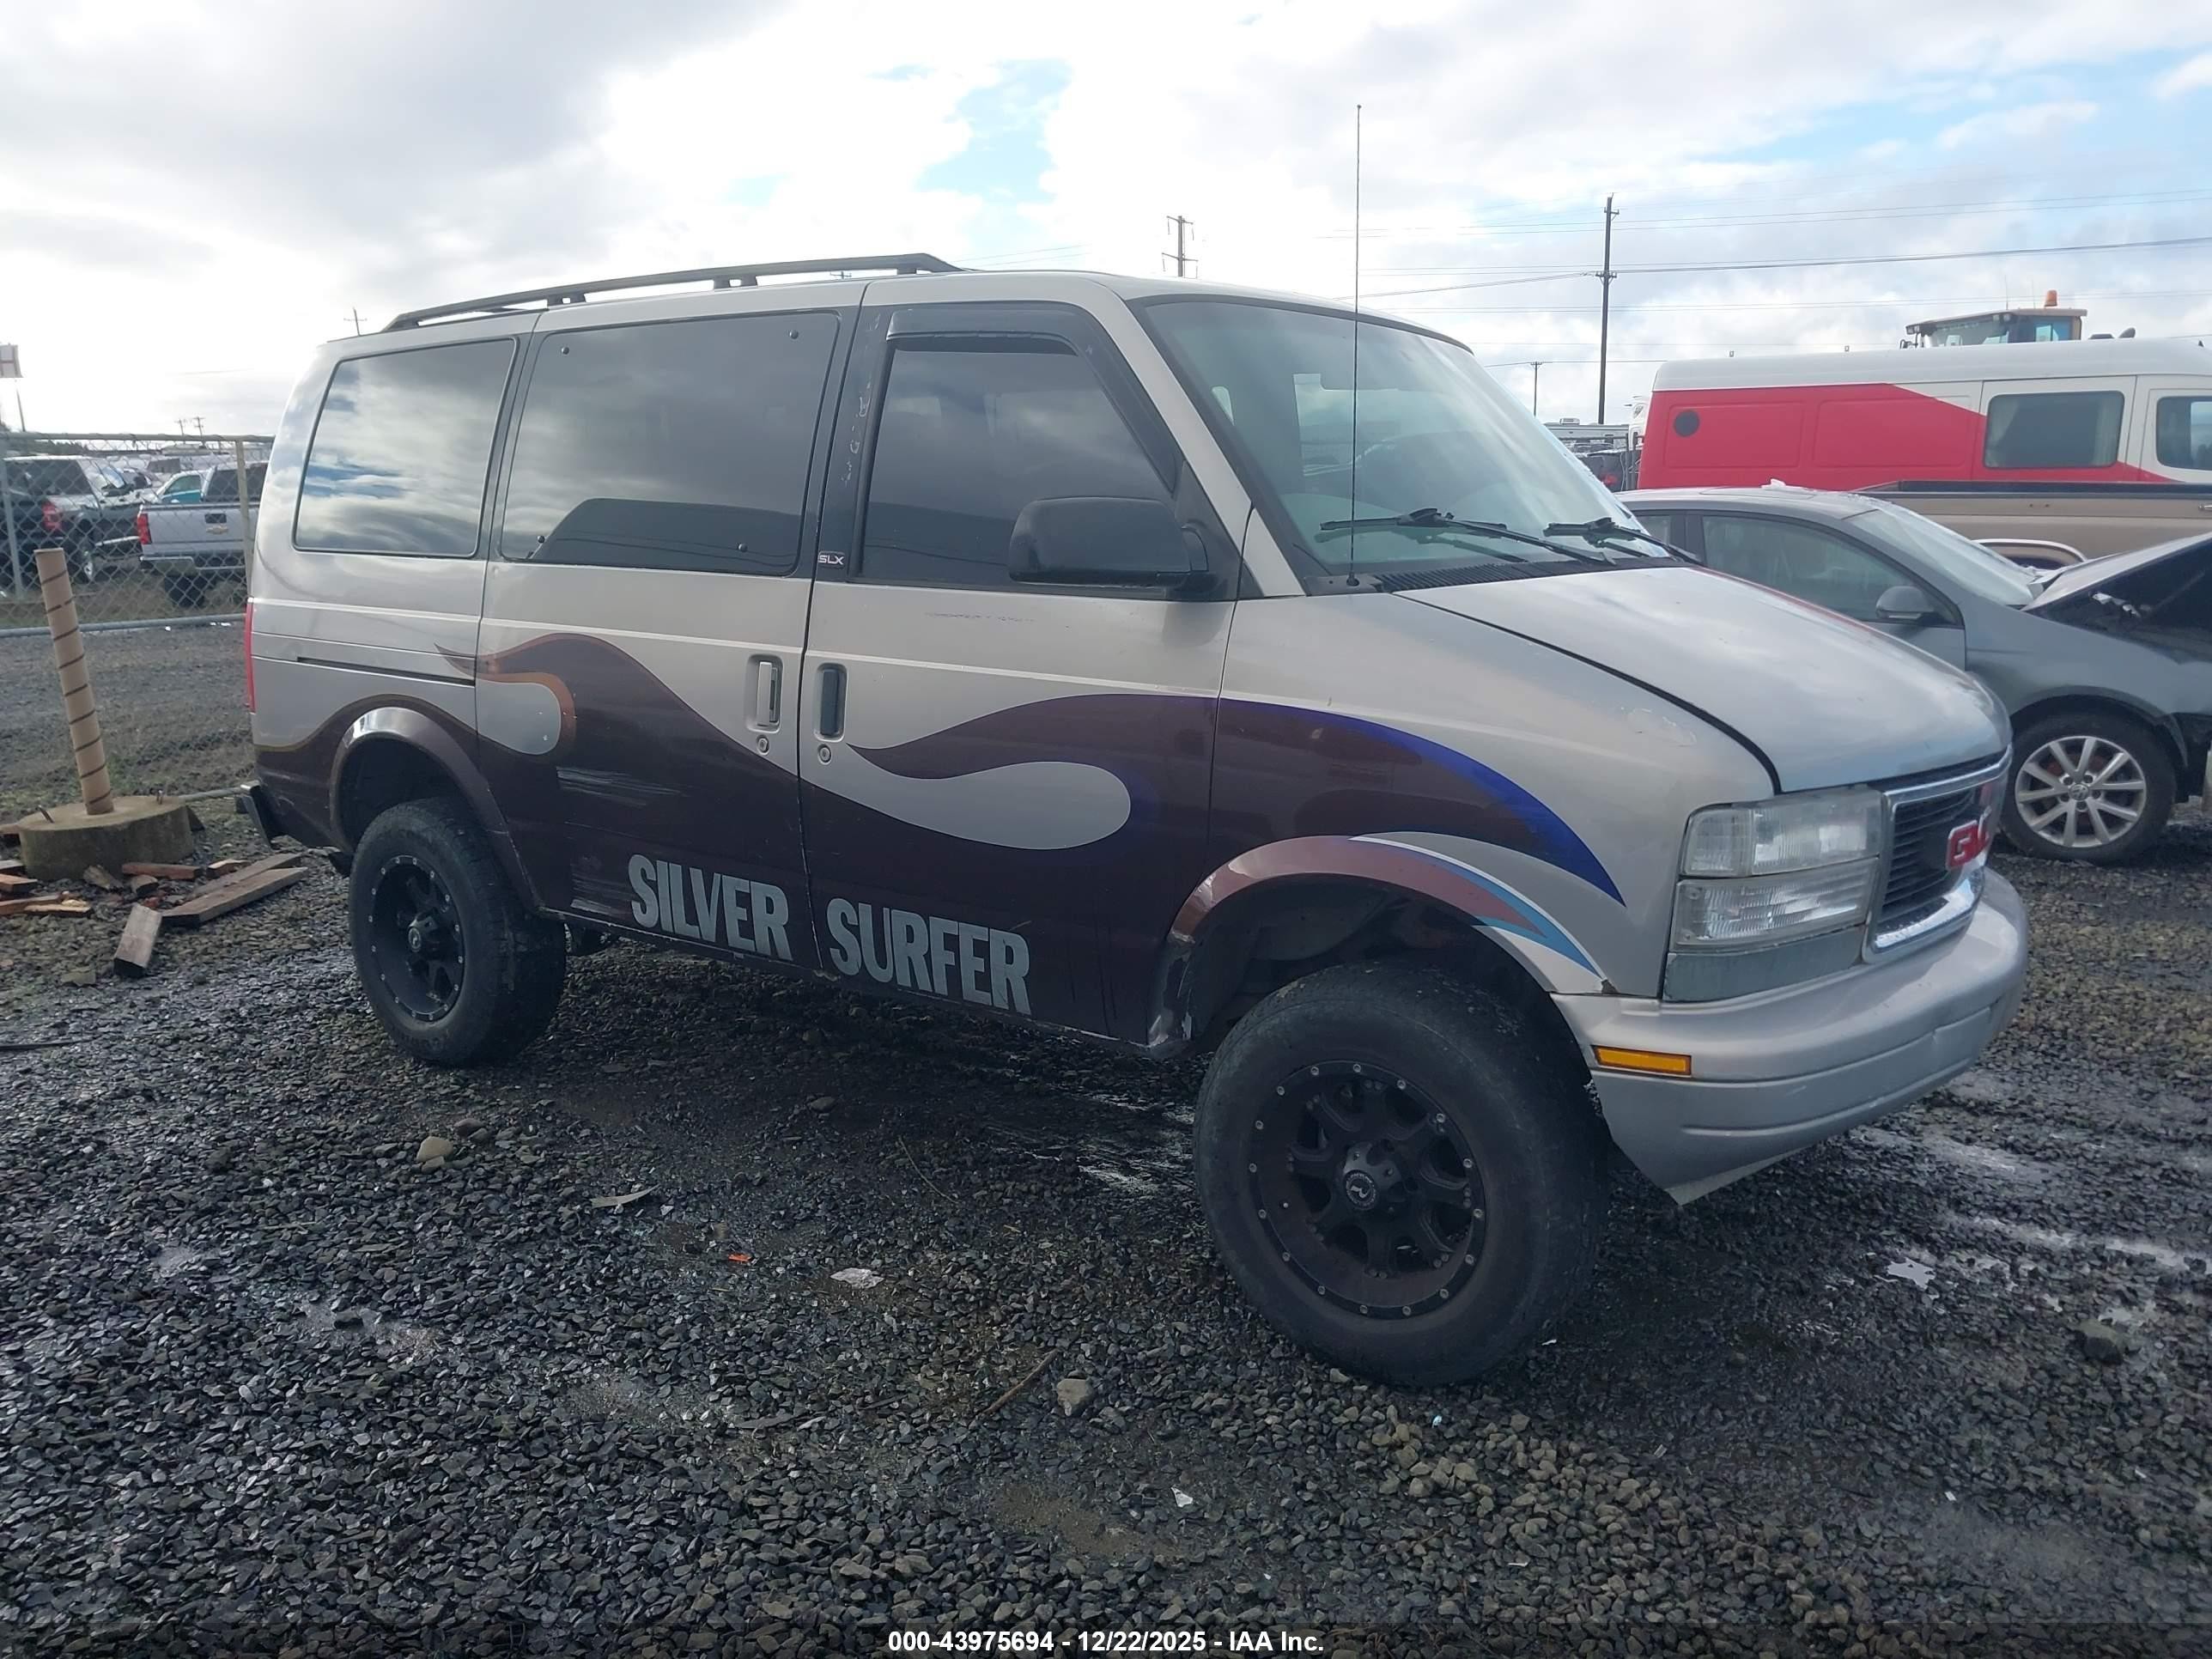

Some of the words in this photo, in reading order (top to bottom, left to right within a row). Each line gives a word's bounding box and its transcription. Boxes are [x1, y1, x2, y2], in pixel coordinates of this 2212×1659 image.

[817, 555, 844, 565] SLX
[629, 854, 793, 961] SILVER
[827, 898, 1031, 1016] SURFER
